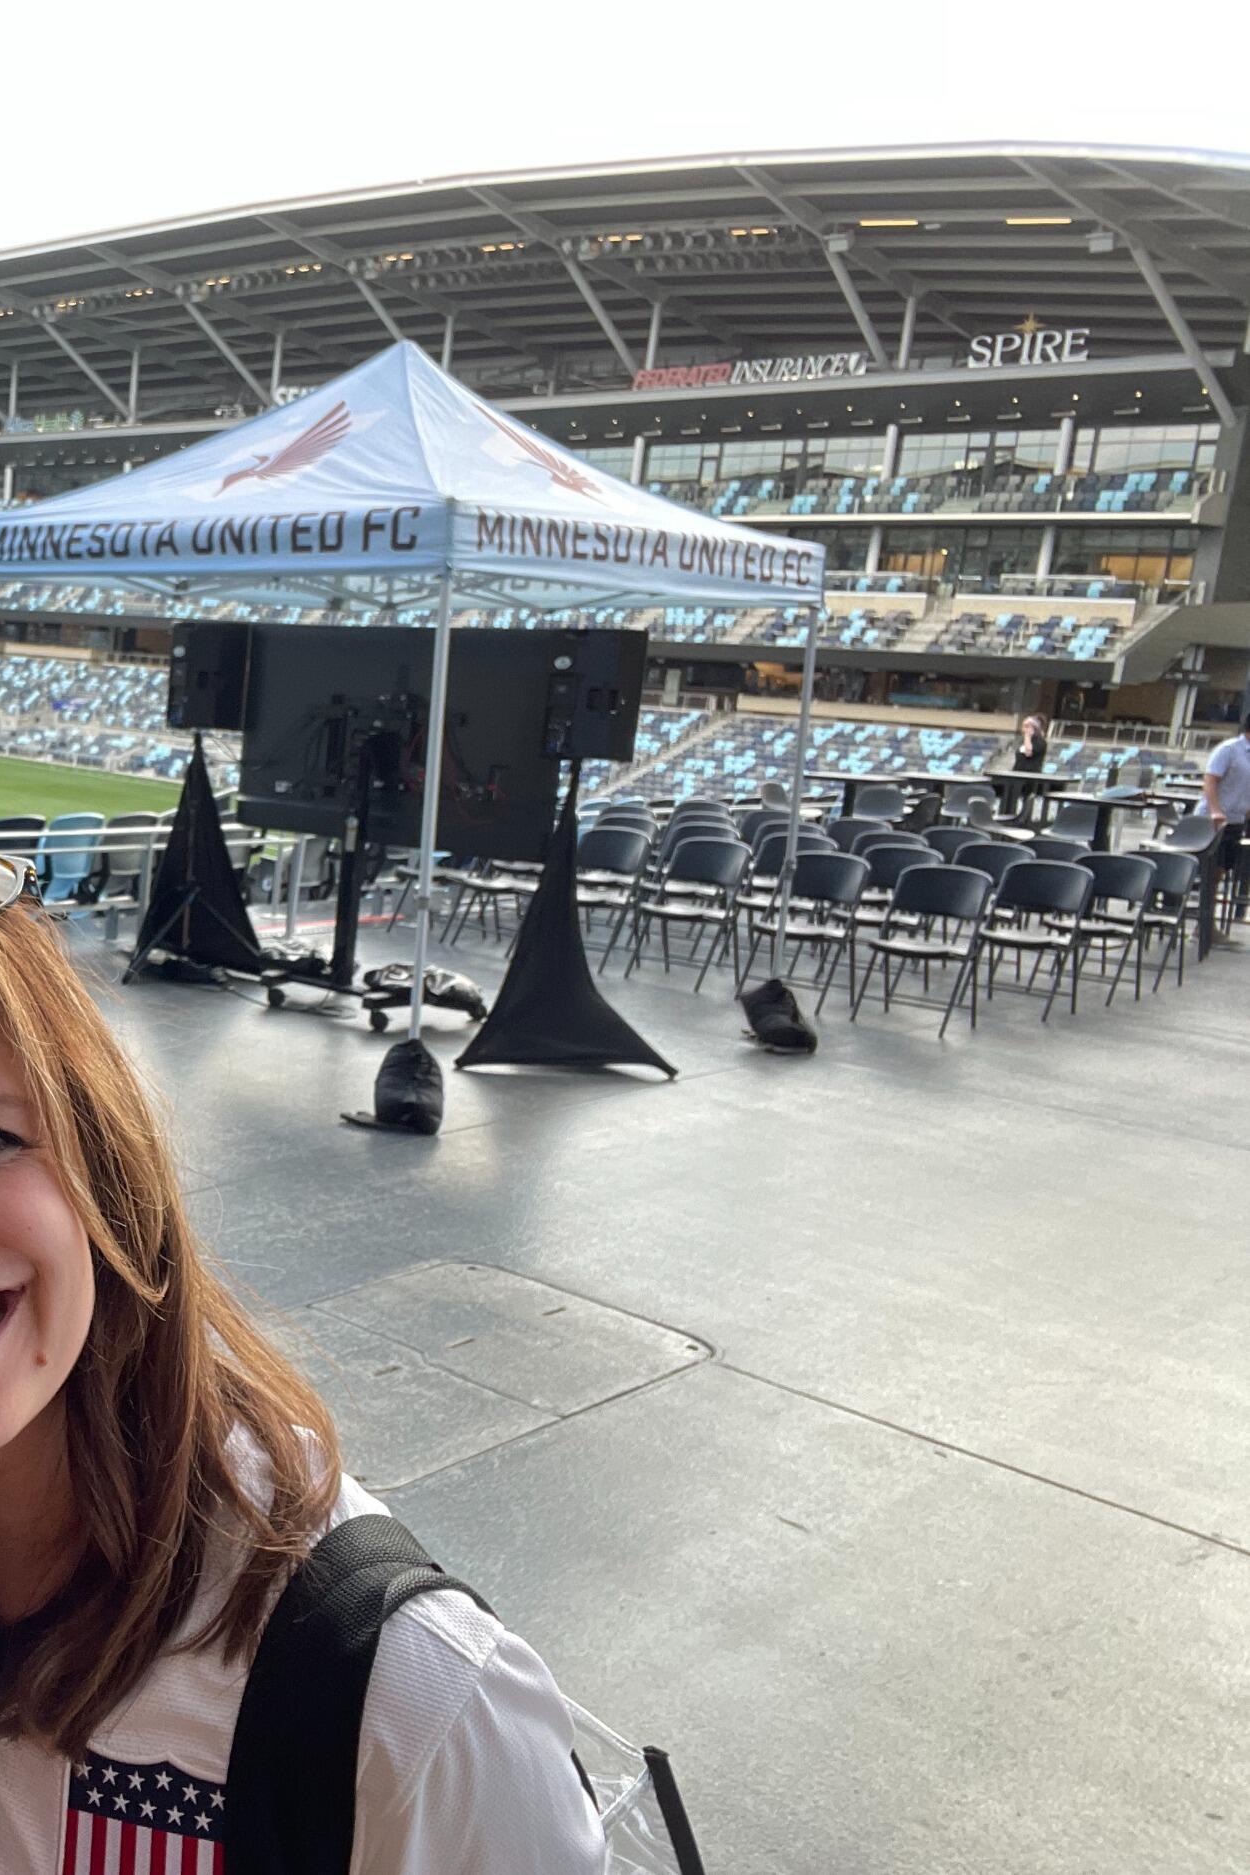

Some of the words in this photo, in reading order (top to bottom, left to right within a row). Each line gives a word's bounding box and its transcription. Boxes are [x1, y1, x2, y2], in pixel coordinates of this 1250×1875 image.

[967, 328, 1090, 369] SPIRE
[632, 362, 731, 391] FEDERATED
[730, 353, 849, 385] INSURANCE
[191, 510, 347, 555] UNITED
[361, 506, 421, 552] FC
[476, 506, 669, 568] MINNESOTA
[678, 532, 775, 585] UNITED
[782, 547, 814, 587] FC
